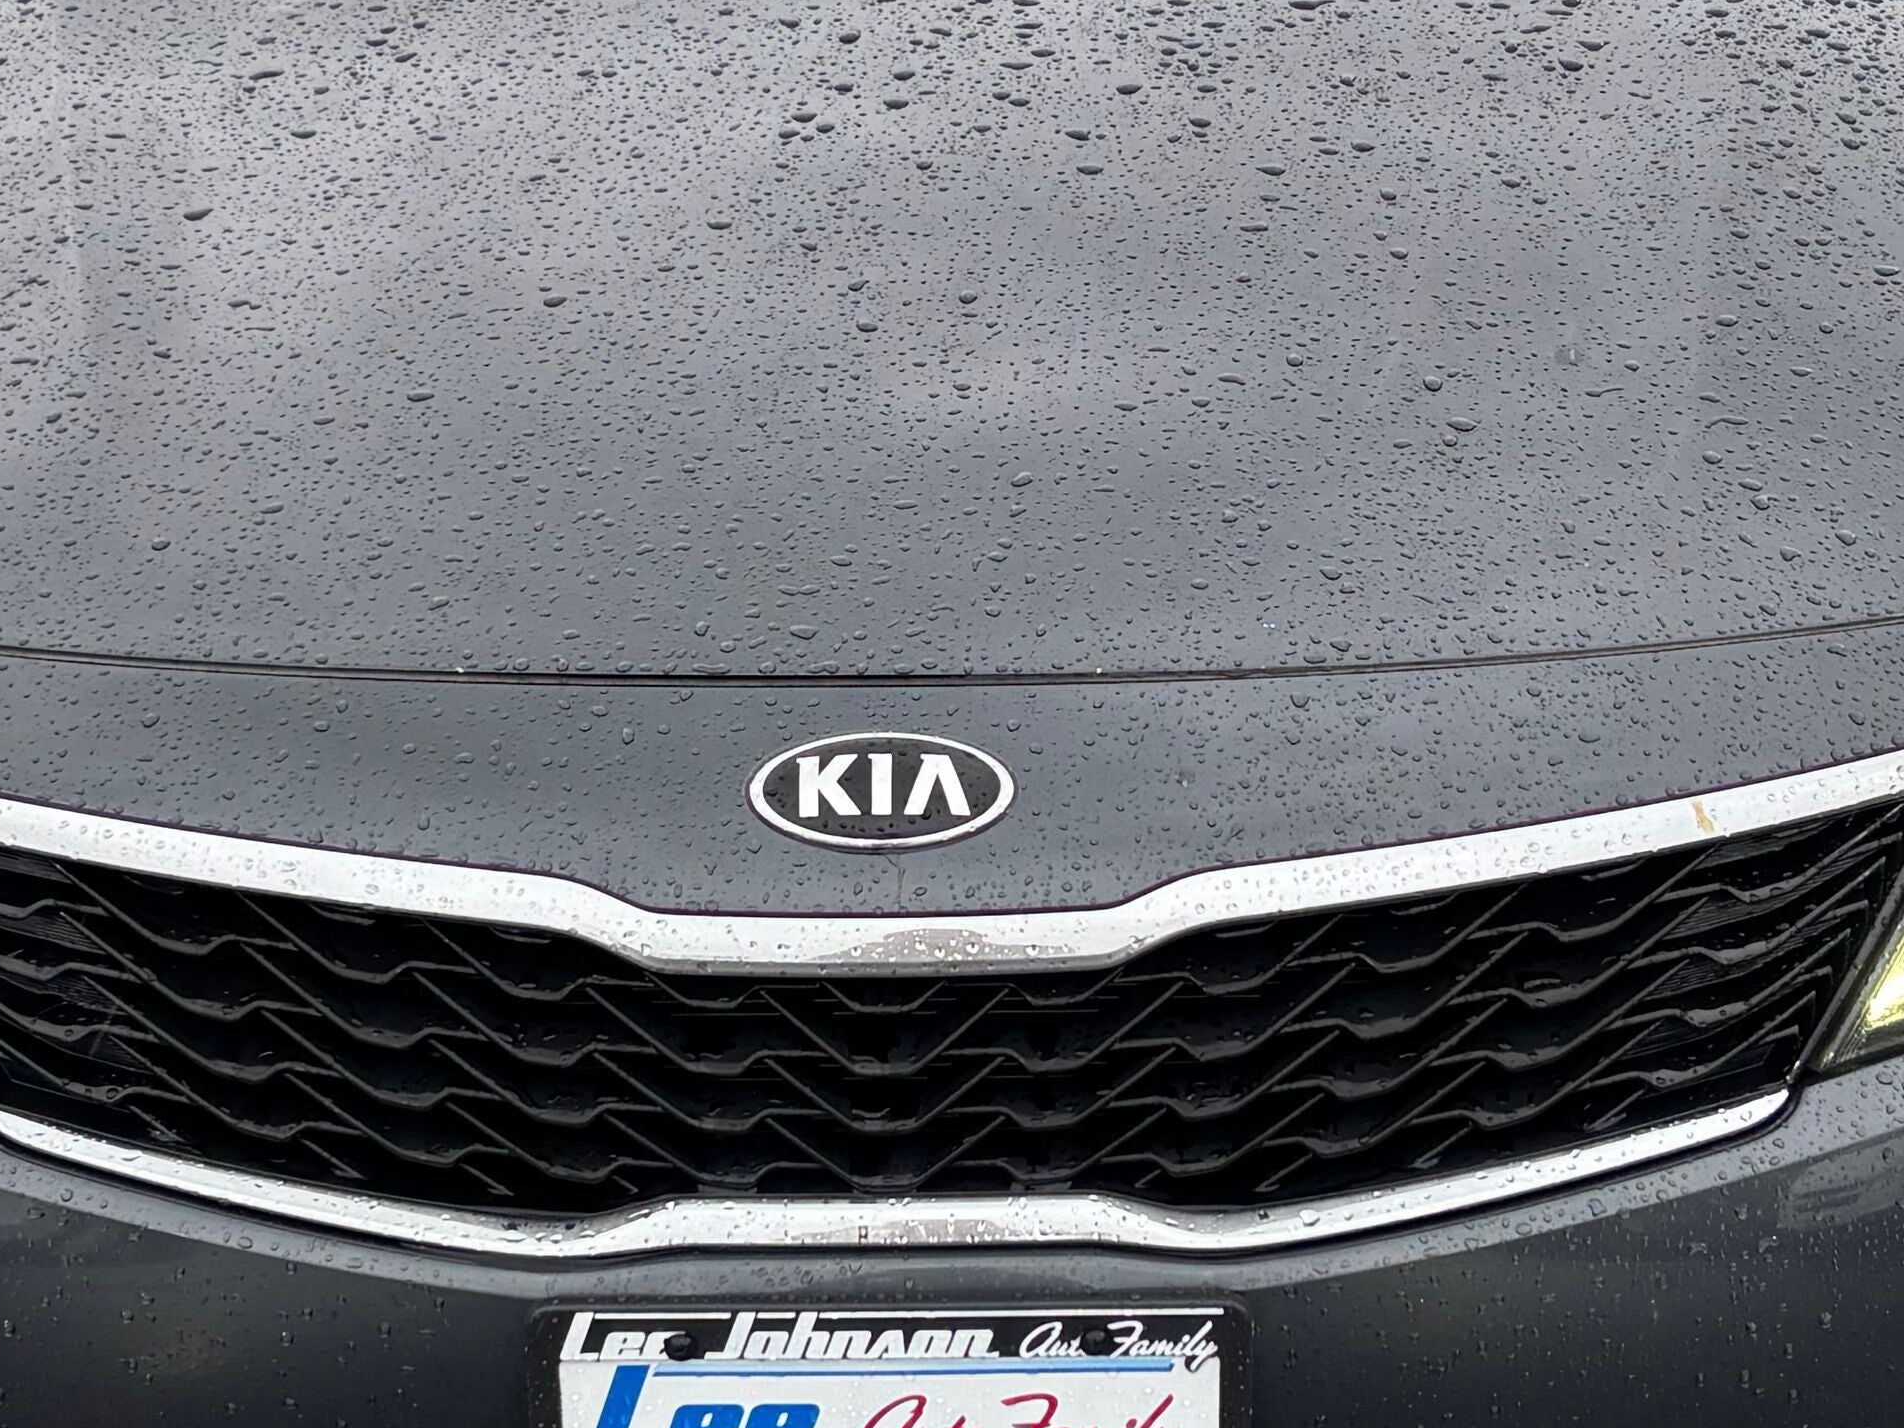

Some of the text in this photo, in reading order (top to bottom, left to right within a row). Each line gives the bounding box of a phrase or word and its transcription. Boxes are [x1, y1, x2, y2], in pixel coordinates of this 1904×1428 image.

[795, 752, 972, 819] KIA
[704, 1311, 1000, 1360] Johnson
[1018, 1321, 1092, 1358] Aut
[1107, 1320, 1219, 1372] Family
